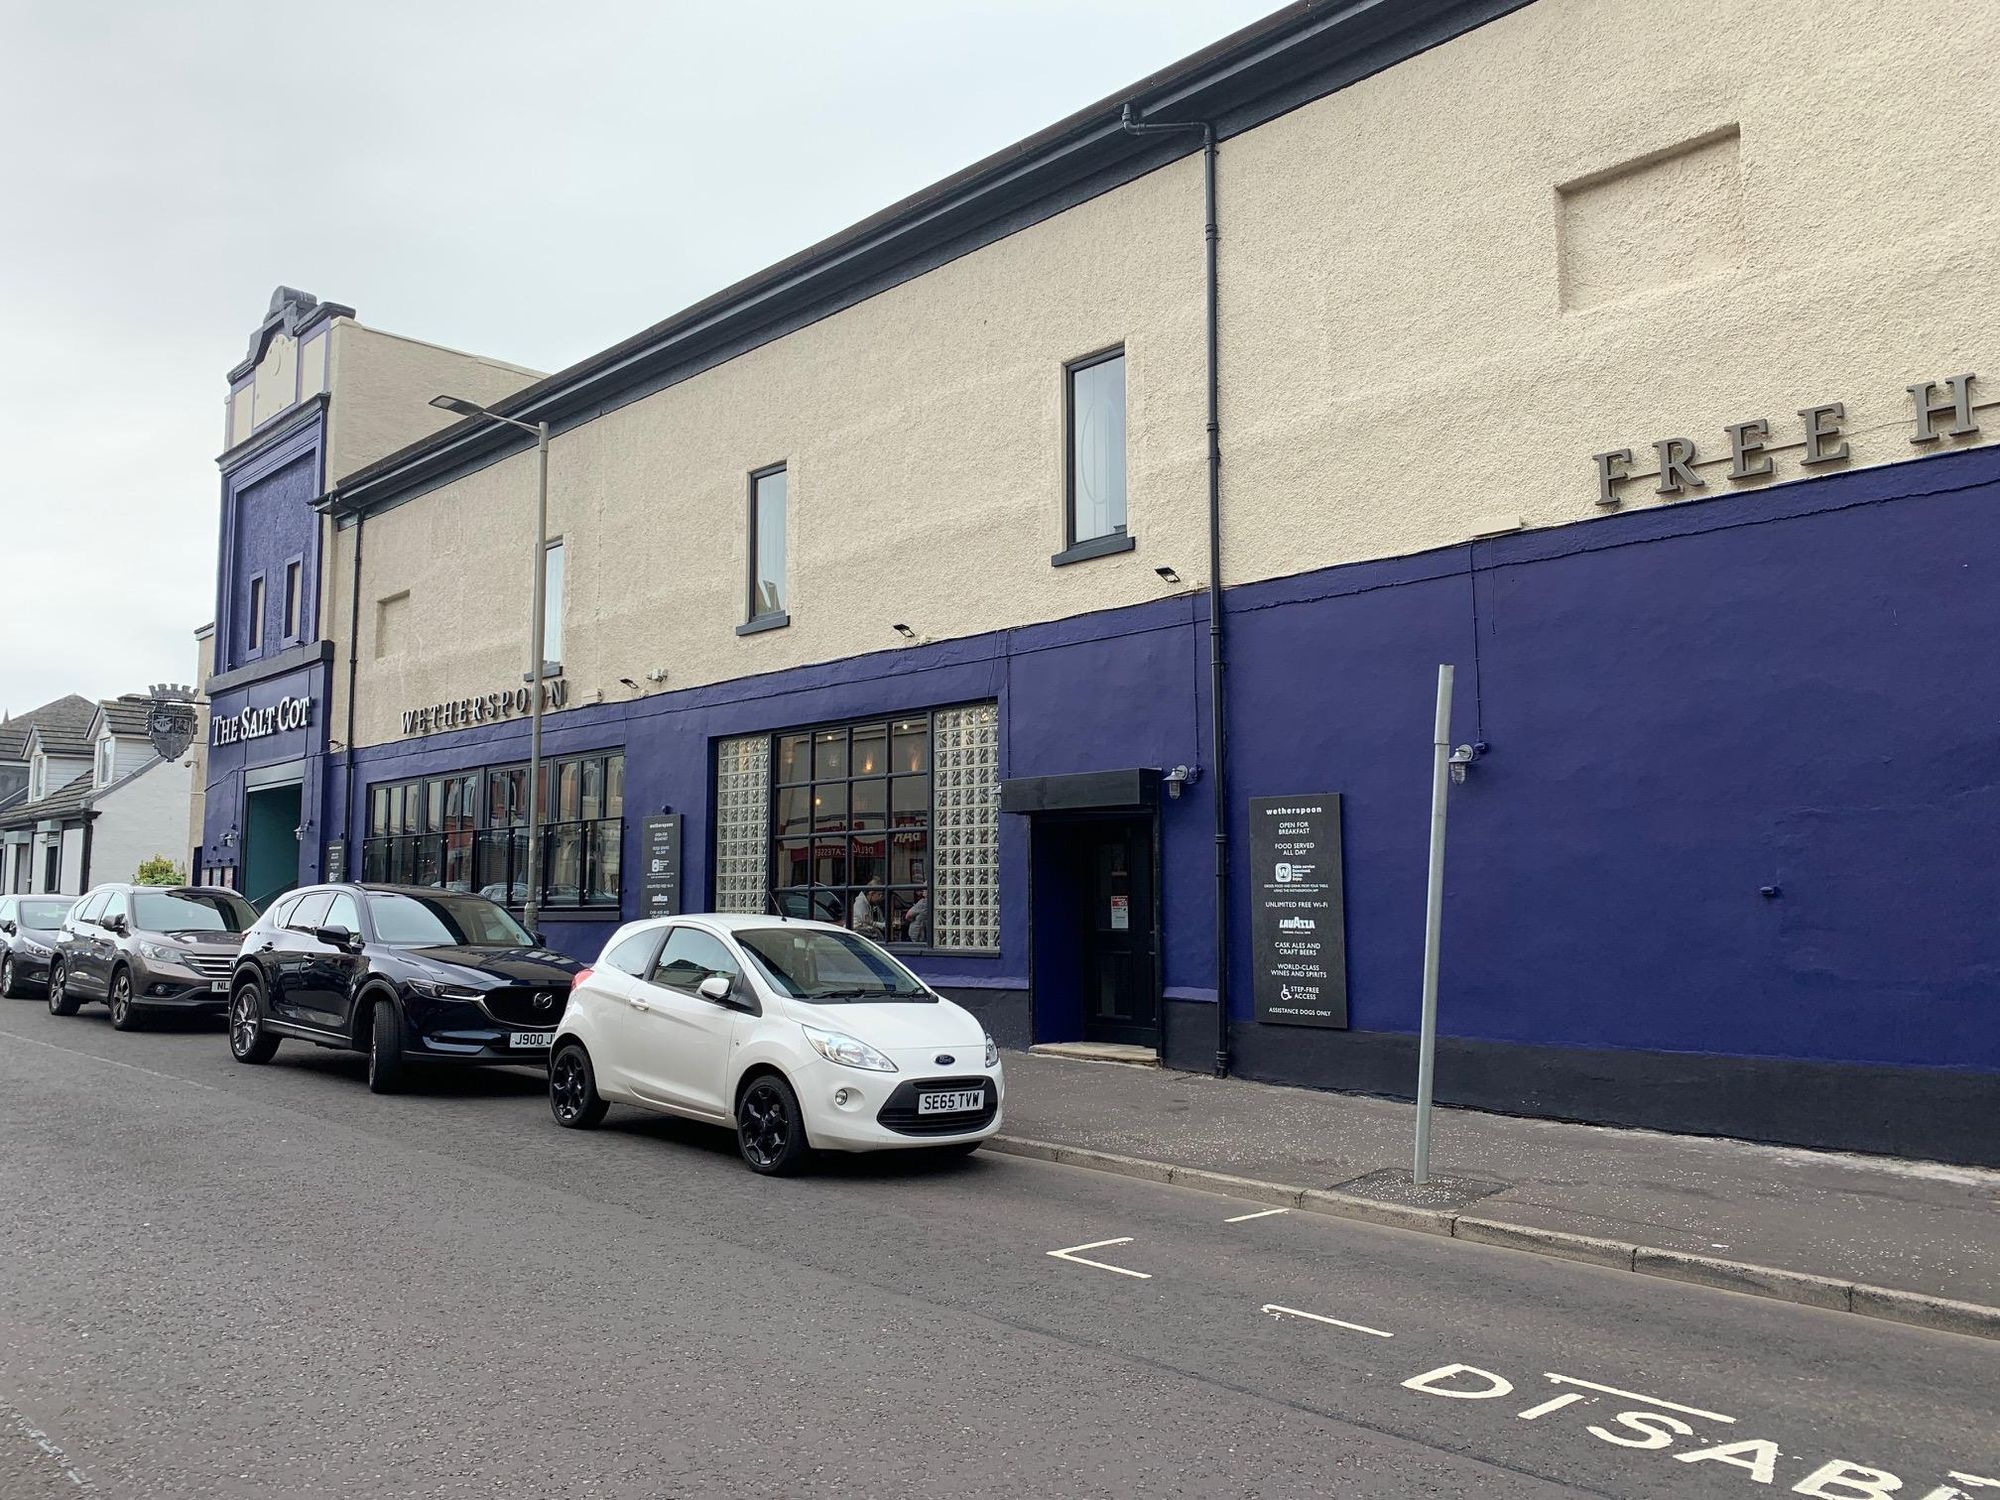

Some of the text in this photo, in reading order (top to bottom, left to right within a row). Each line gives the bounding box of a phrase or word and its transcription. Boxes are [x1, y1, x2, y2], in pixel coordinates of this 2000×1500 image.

[1592, 402, 1850, 506] FREE
[401, 679, 567, 734] WETHERSPON
[1266, 807, 1322, 815] wetherspoon
[1279, 917, 1315, 929] LAVAZZA
[515, 1034, 543, 1045] J900
[924, 1091, 980, 1110] SE65 TVW
